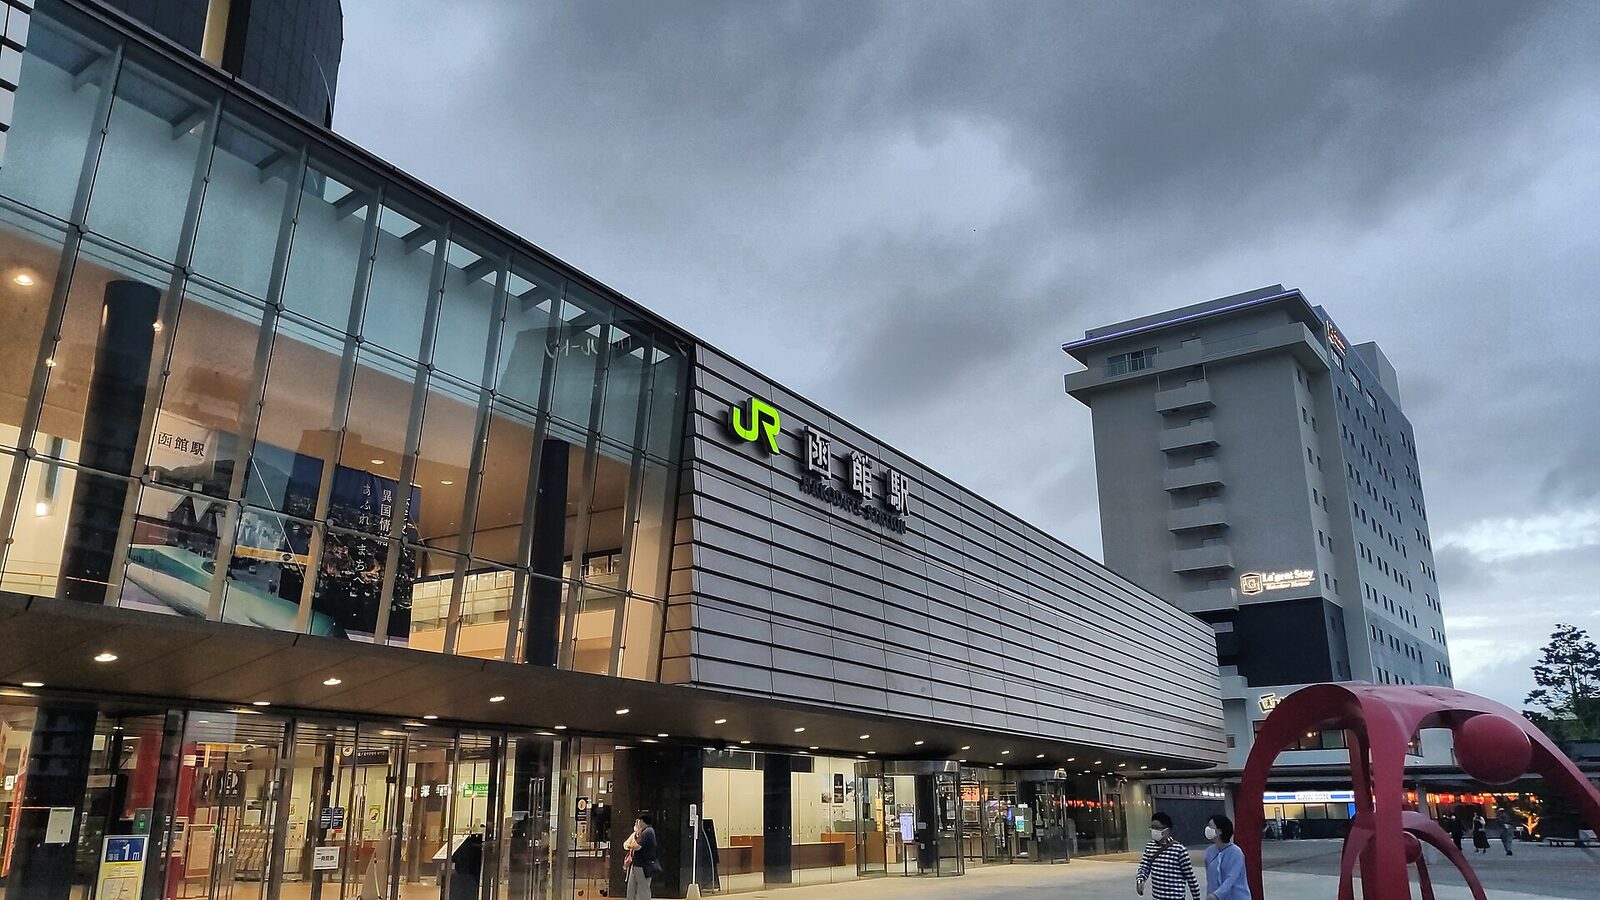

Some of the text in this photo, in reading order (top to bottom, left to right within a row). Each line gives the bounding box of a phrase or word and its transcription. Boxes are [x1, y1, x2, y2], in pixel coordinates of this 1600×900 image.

[158, 432, 205, 457] 函館駅
[732, 397, 781, 455] JR
[804, 425, 910, 517] 函館駅
[122, 843, 131, 860] 1
